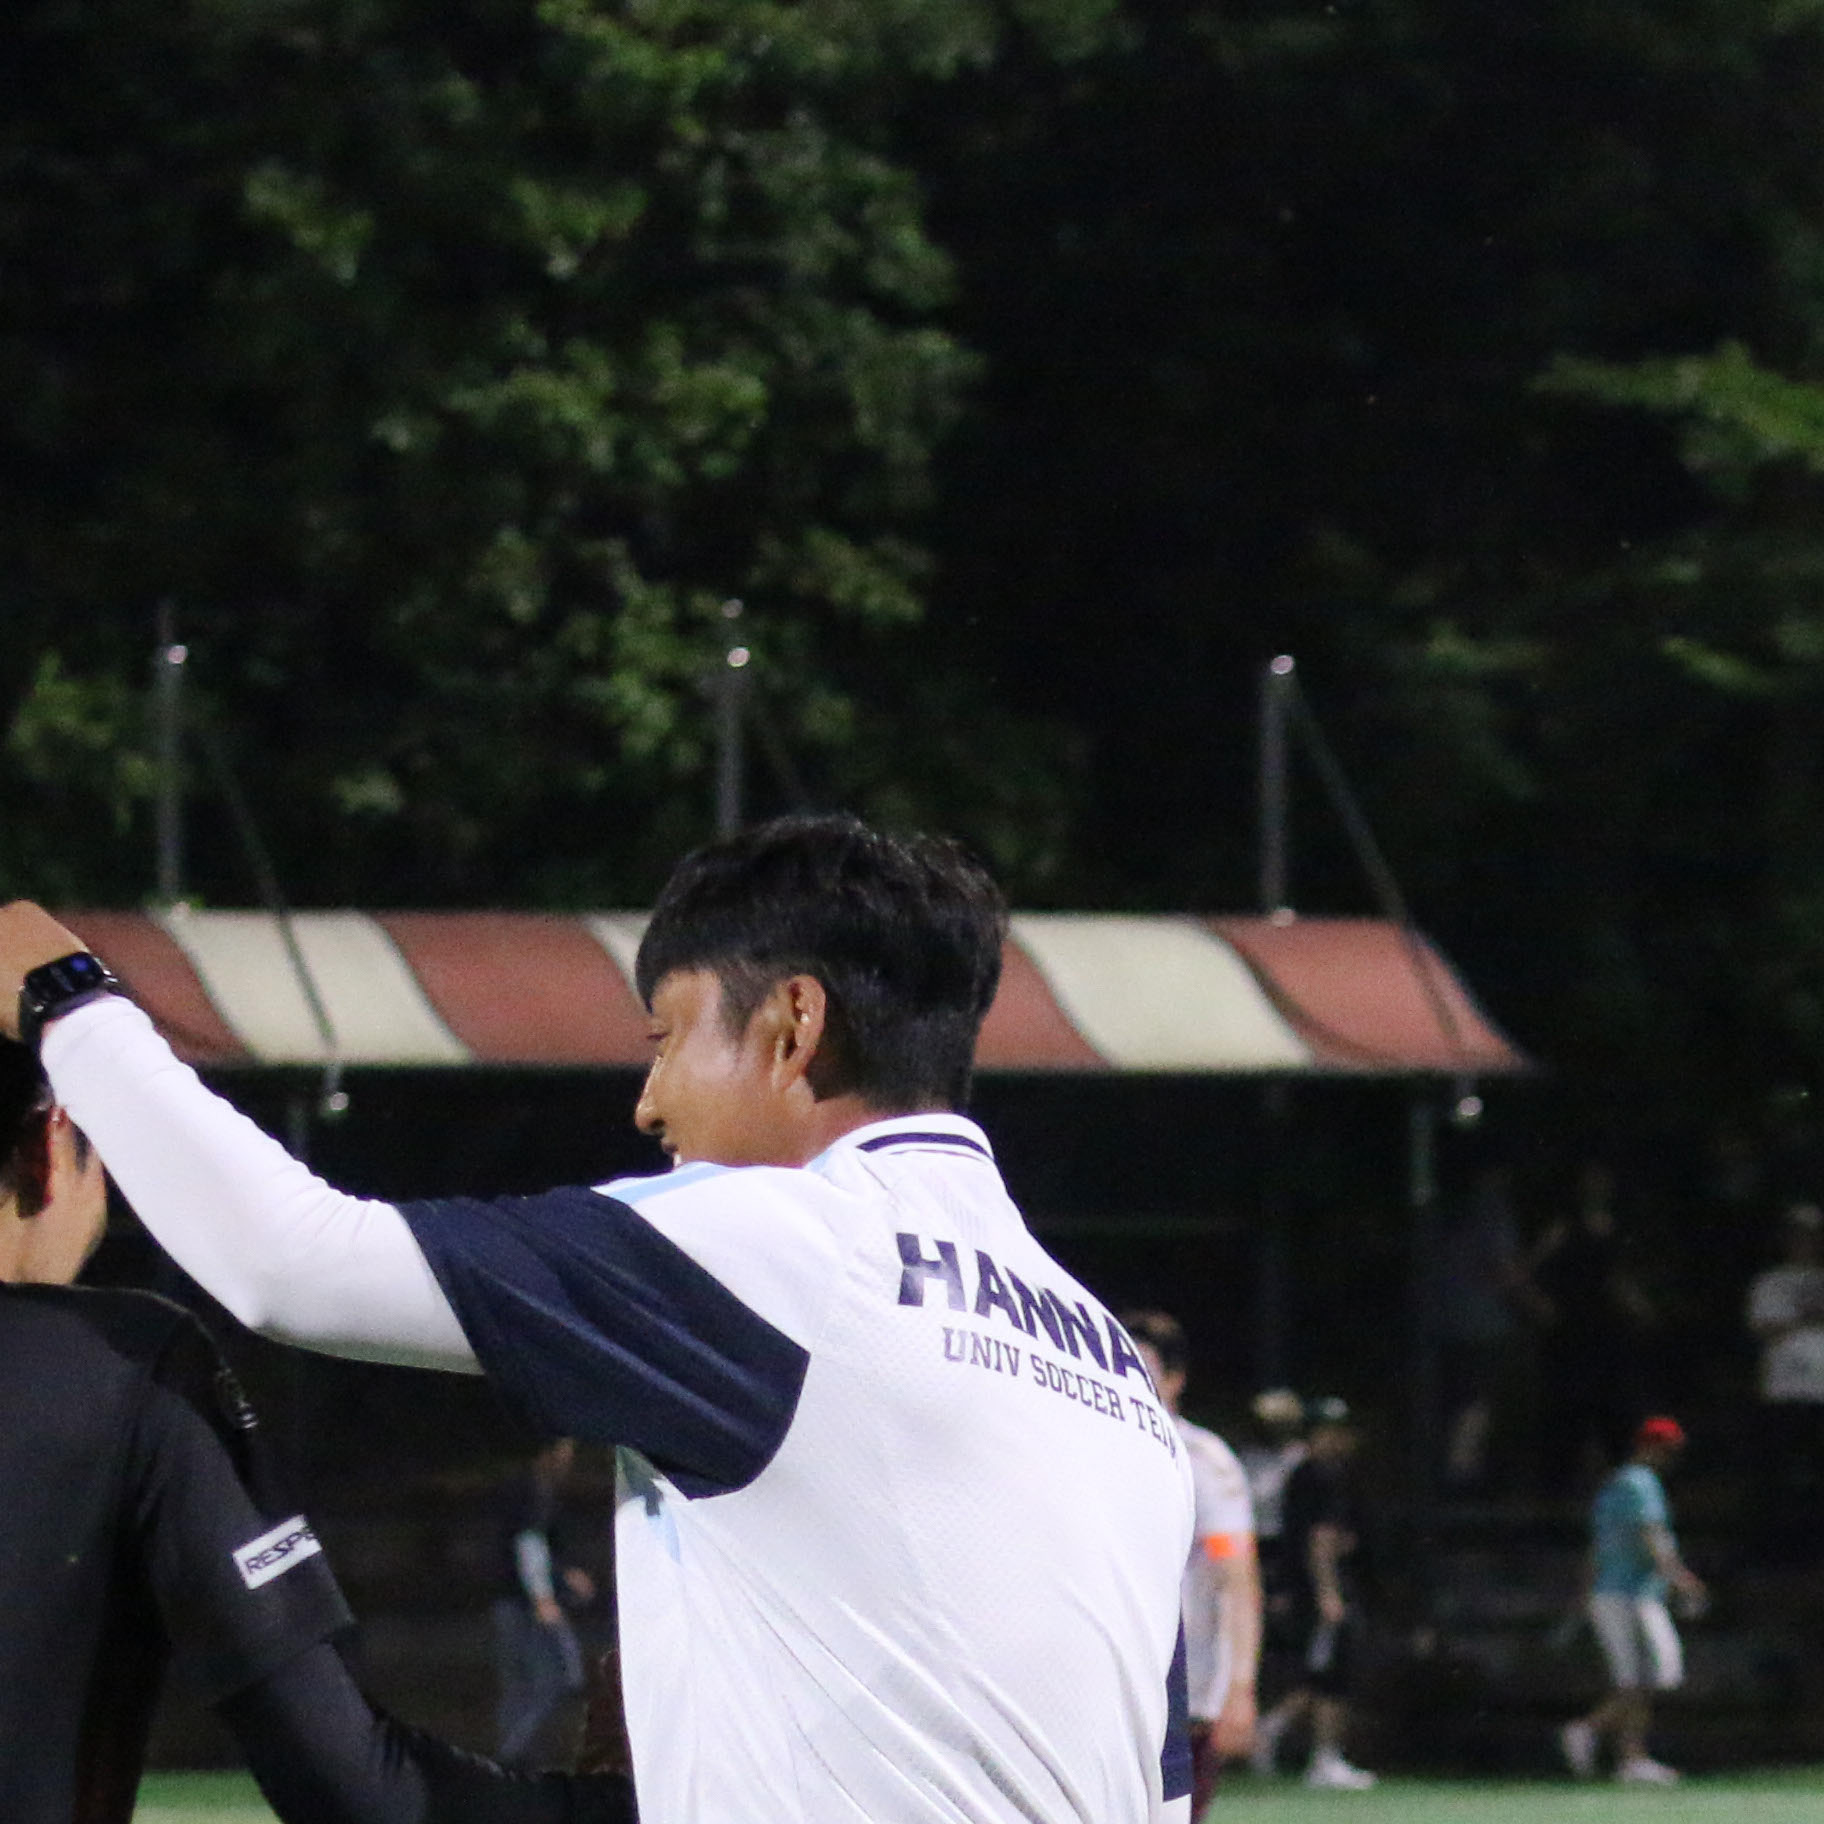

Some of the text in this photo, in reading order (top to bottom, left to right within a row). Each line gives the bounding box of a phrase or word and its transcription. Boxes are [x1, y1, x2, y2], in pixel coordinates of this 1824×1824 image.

[896, 1232, 1161, 1406] HANNA
[942, 1326, 1021, 1378] UNIV
[1031, 1354, 1127, 1423] SOCCER
